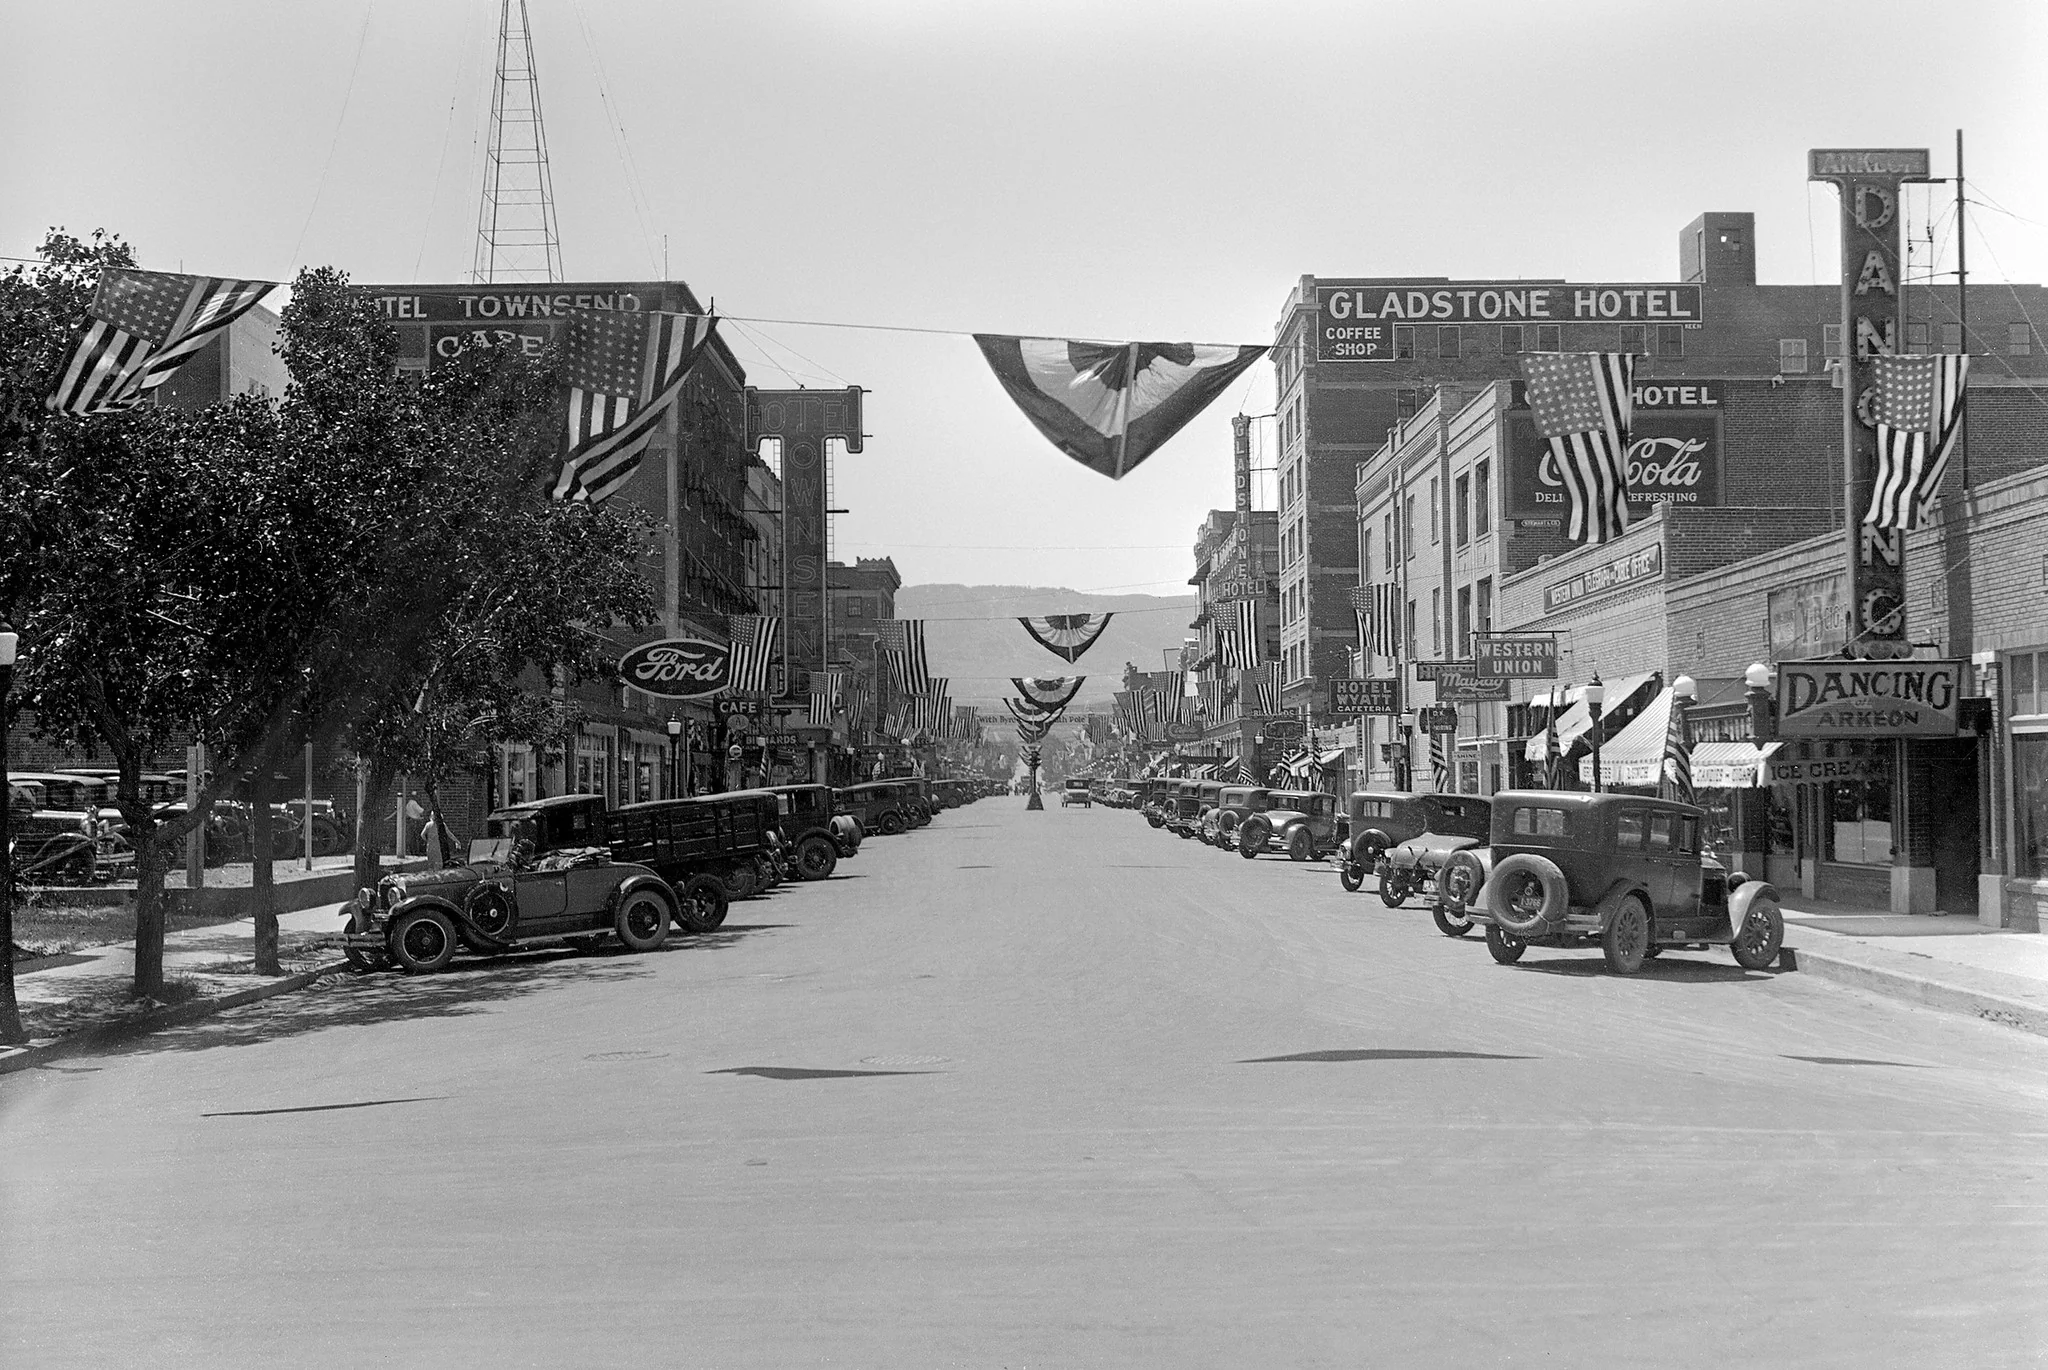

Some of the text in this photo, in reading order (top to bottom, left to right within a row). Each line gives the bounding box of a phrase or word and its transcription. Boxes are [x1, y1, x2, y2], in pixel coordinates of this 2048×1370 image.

[458, 294, 641, 318] TOWNSEND
[1329, 290, 1691, 319] GLADSTONE HOTEL
[1325, 327, 1381, 341] COFFEE
[1335, 343, 1377, 356] SHOP
[748, 396, 858, 433] HOTEL
[1234, 422, 1248, 580] GLADSTONE
[1628, 492, 1698, 502] EFRESHING
[1222, 583, 1264, 597] HOTEL
[1480, 643, 1554, 657] WESTERN
[635, 647, 724, 682] Ford
[1493, 660, 1542, 674] UNION
[1337, 681, 1392, 694] HOTEL
[1785, 670, 1955, 716] DANCING
[1336, 694, 1392, 705] WYATT
[719, 701, 757, 714] CAFE
[1817, 709, 1920, 728] ARKEON
[1771, 765, 1802, 781] ICE
